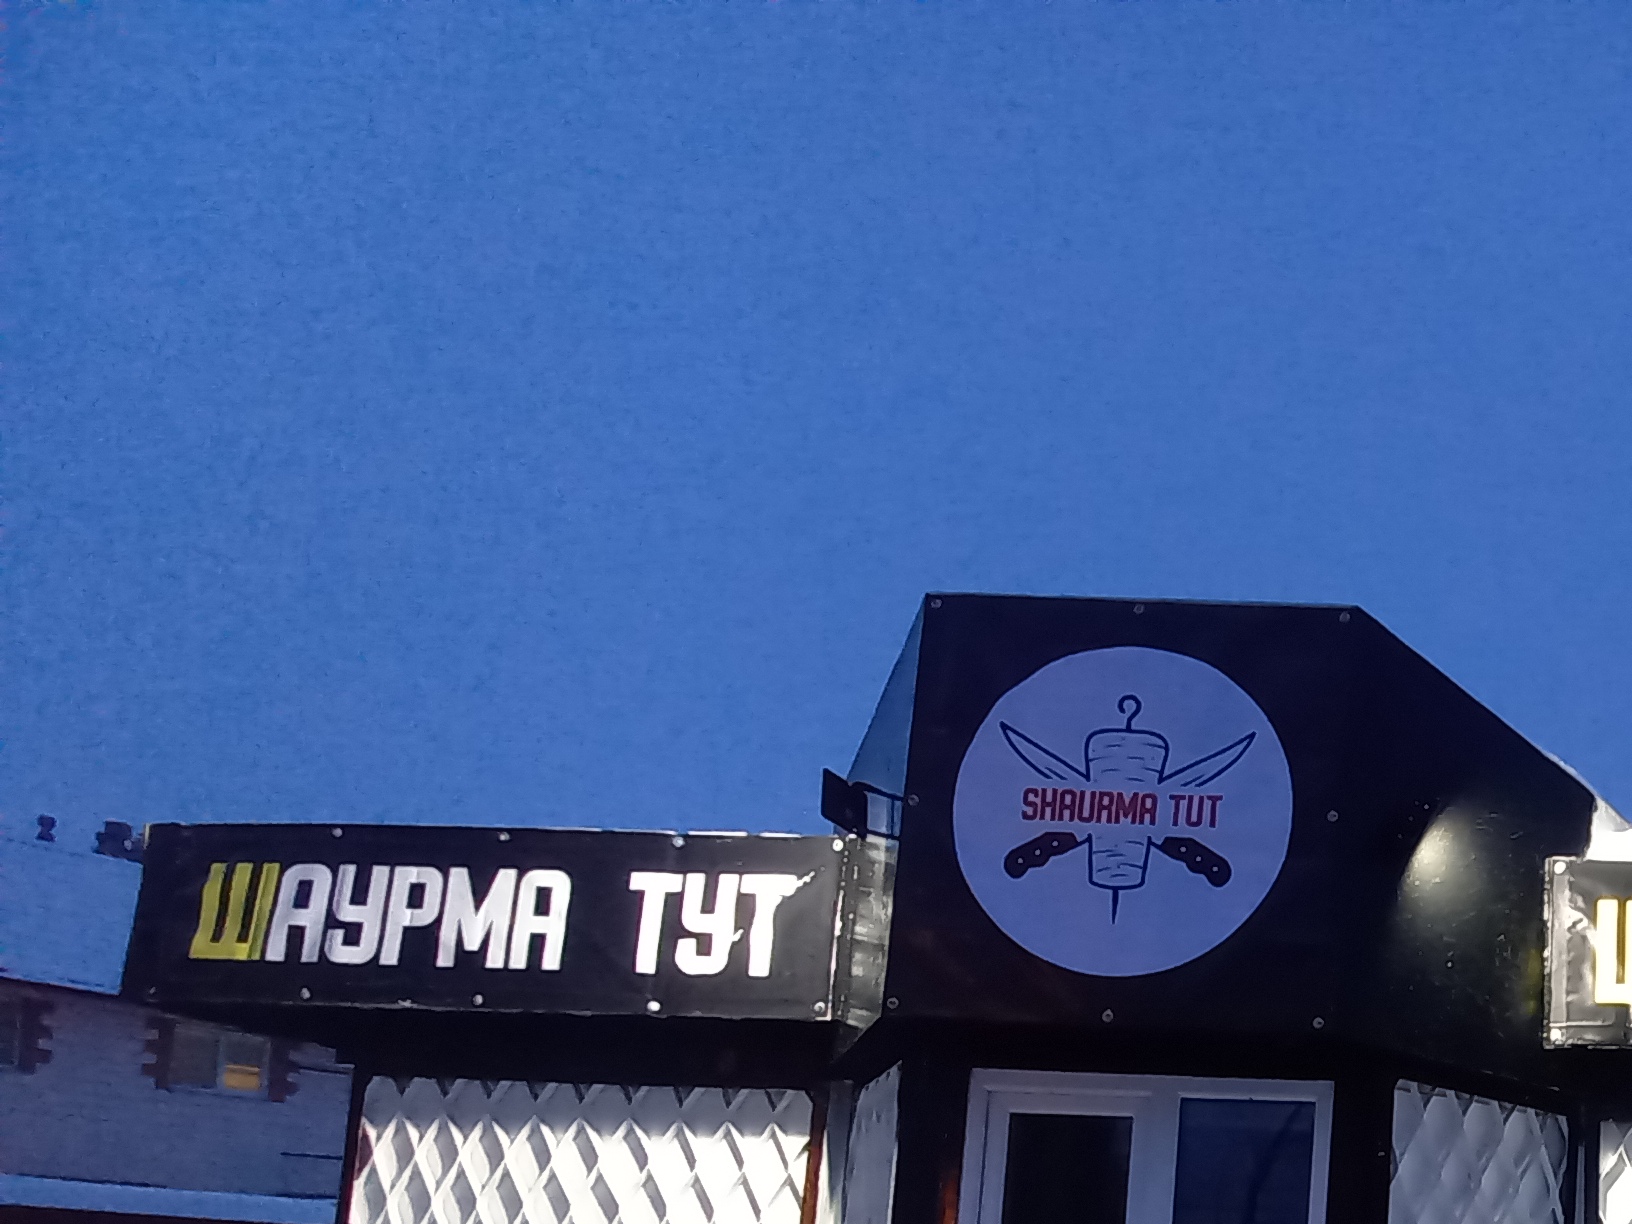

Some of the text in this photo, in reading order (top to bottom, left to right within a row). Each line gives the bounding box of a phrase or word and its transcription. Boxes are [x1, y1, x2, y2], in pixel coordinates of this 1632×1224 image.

[1021, 788, 1224, 828] SHAURMA TUT
[188, 862, 800, 978] ШАУРМА ТУТ
